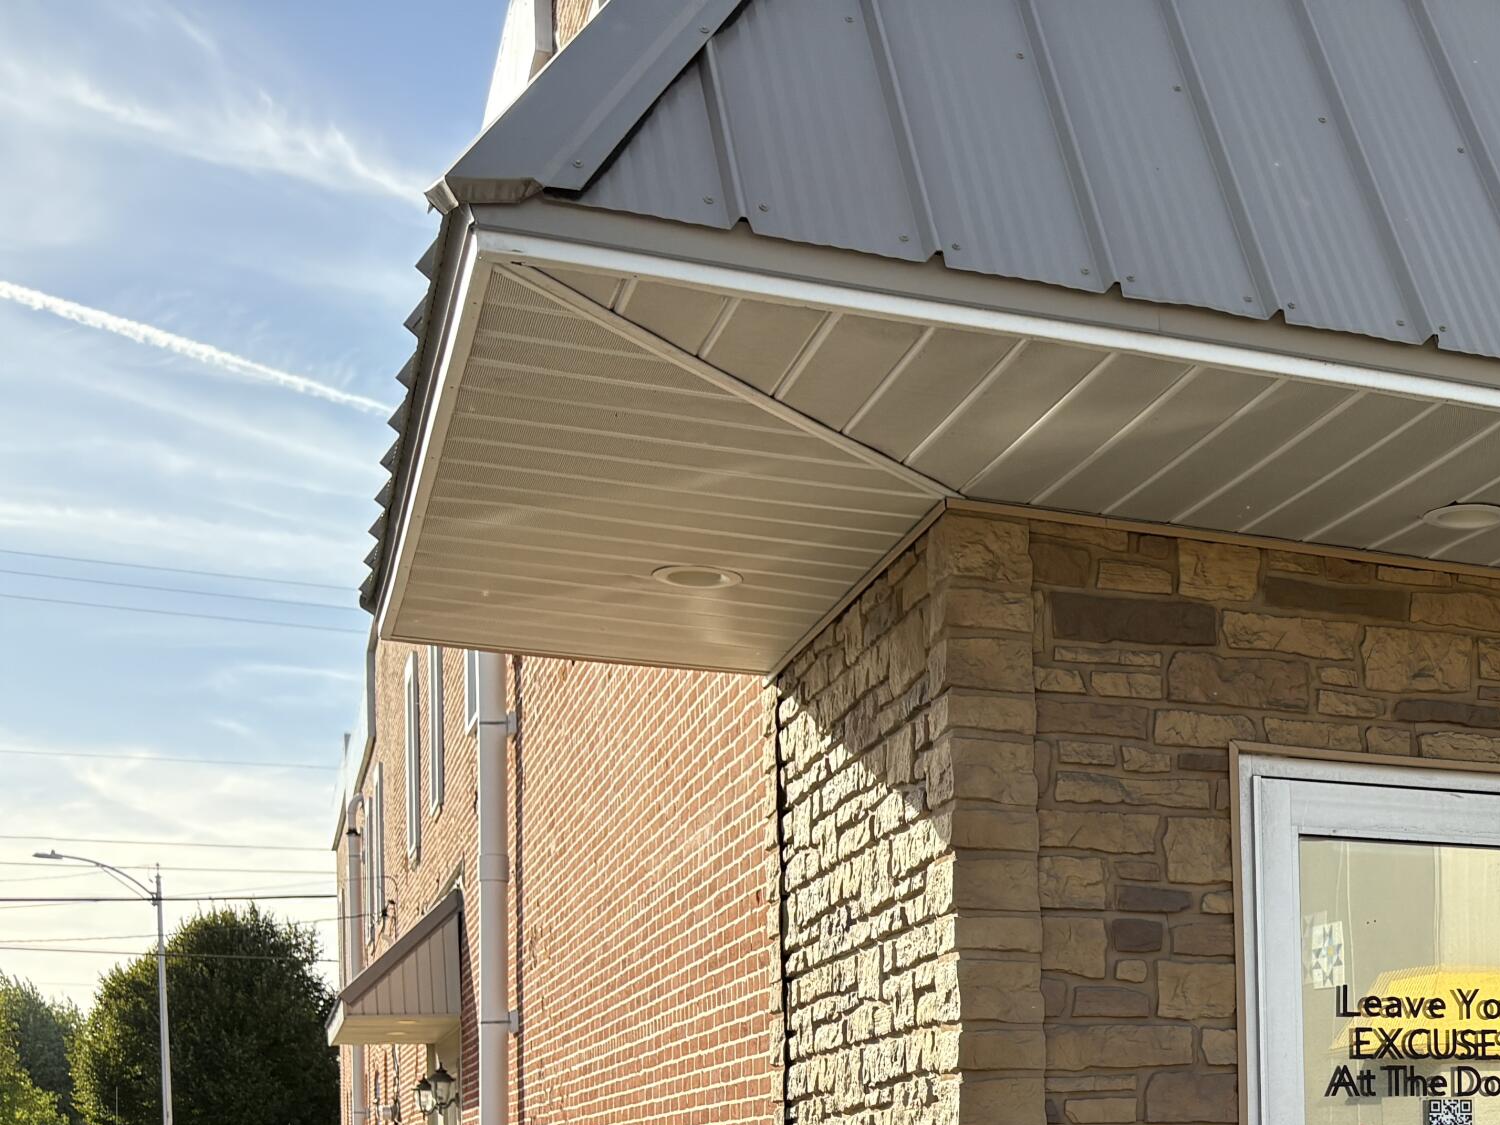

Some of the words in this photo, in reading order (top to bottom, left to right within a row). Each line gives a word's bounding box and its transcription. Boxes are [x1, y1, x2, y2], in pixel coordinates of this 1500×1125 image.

[1341, 984, 1446, 1018] Leave
[1329, 1064, 1376, 1097] At
[1384, 1065, 1447, 1097] The
